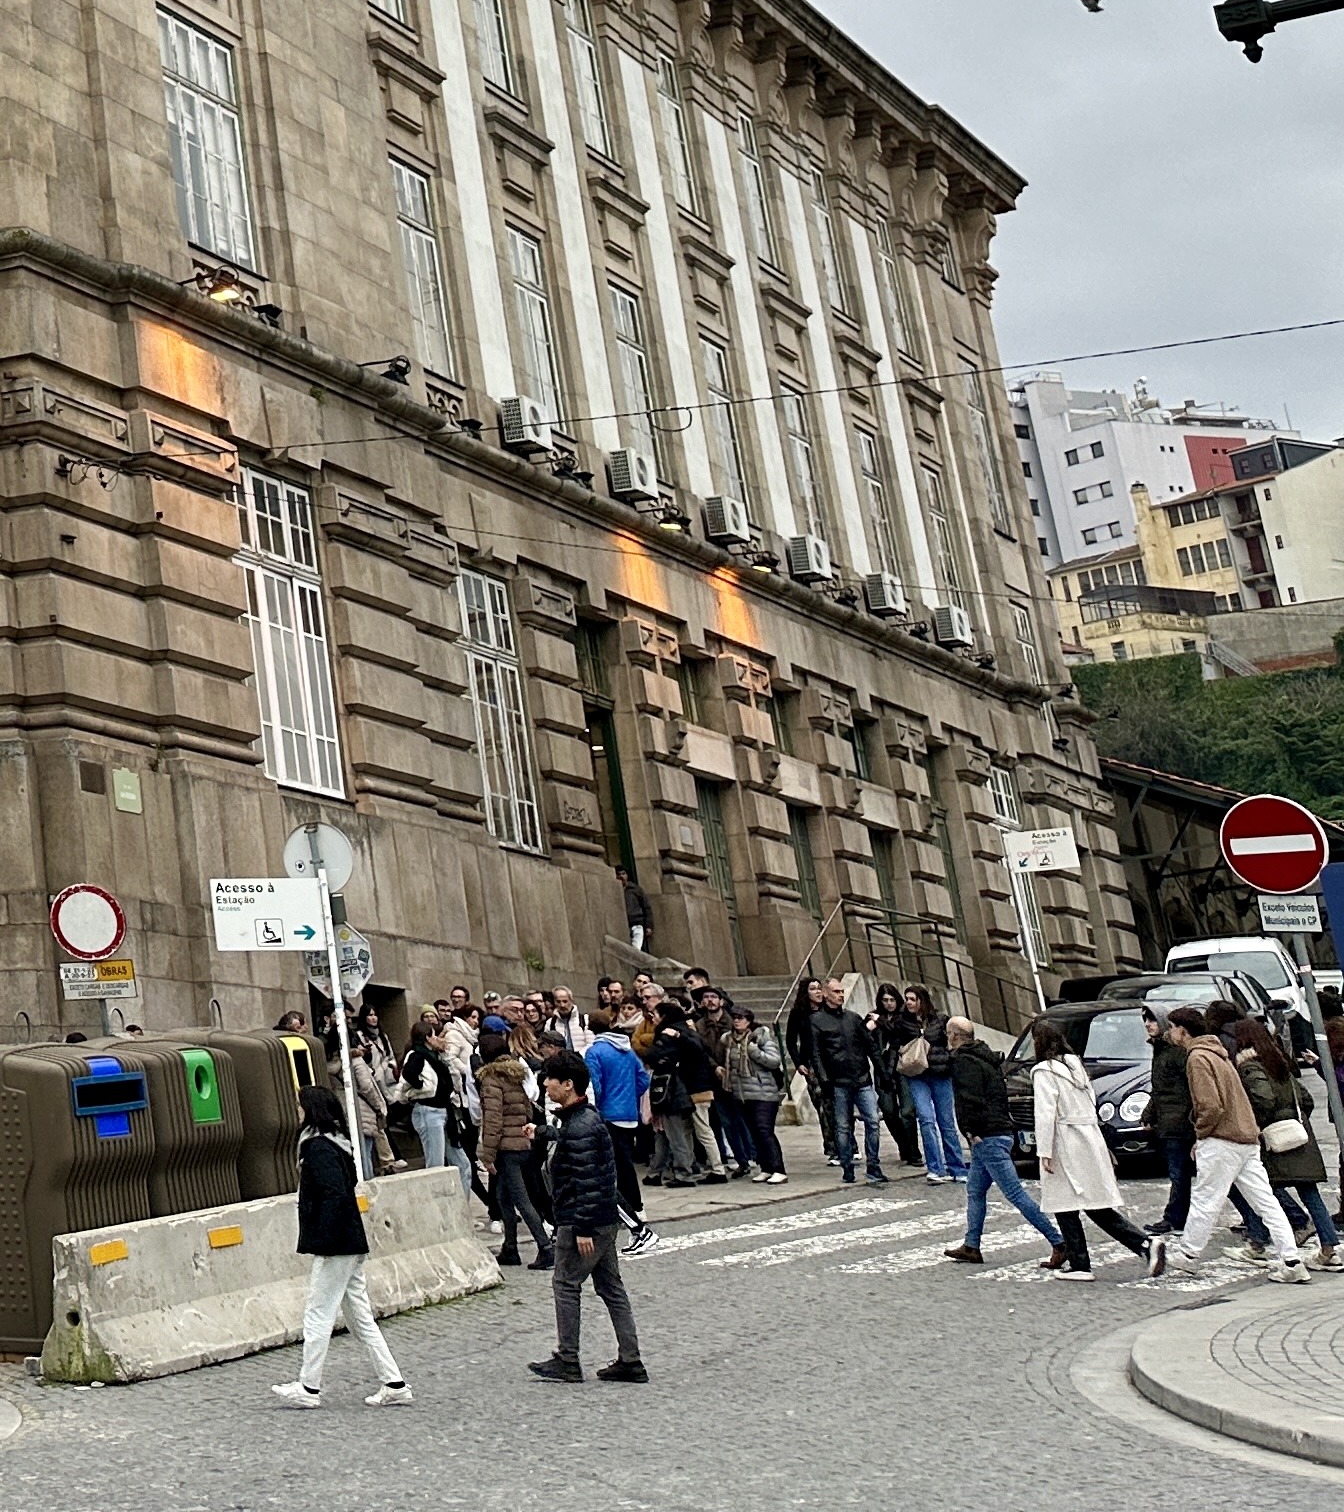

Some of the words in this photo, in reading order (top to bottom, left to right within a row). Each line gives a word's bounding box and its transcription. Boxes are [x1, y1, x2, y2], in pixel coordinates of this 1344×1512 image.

[216, 882, 263, 893] Acesso
[267, 882, 275, 893] à
[215, 896, 255, 905] Estação
[100, 966, 128, 977] OBRAS
